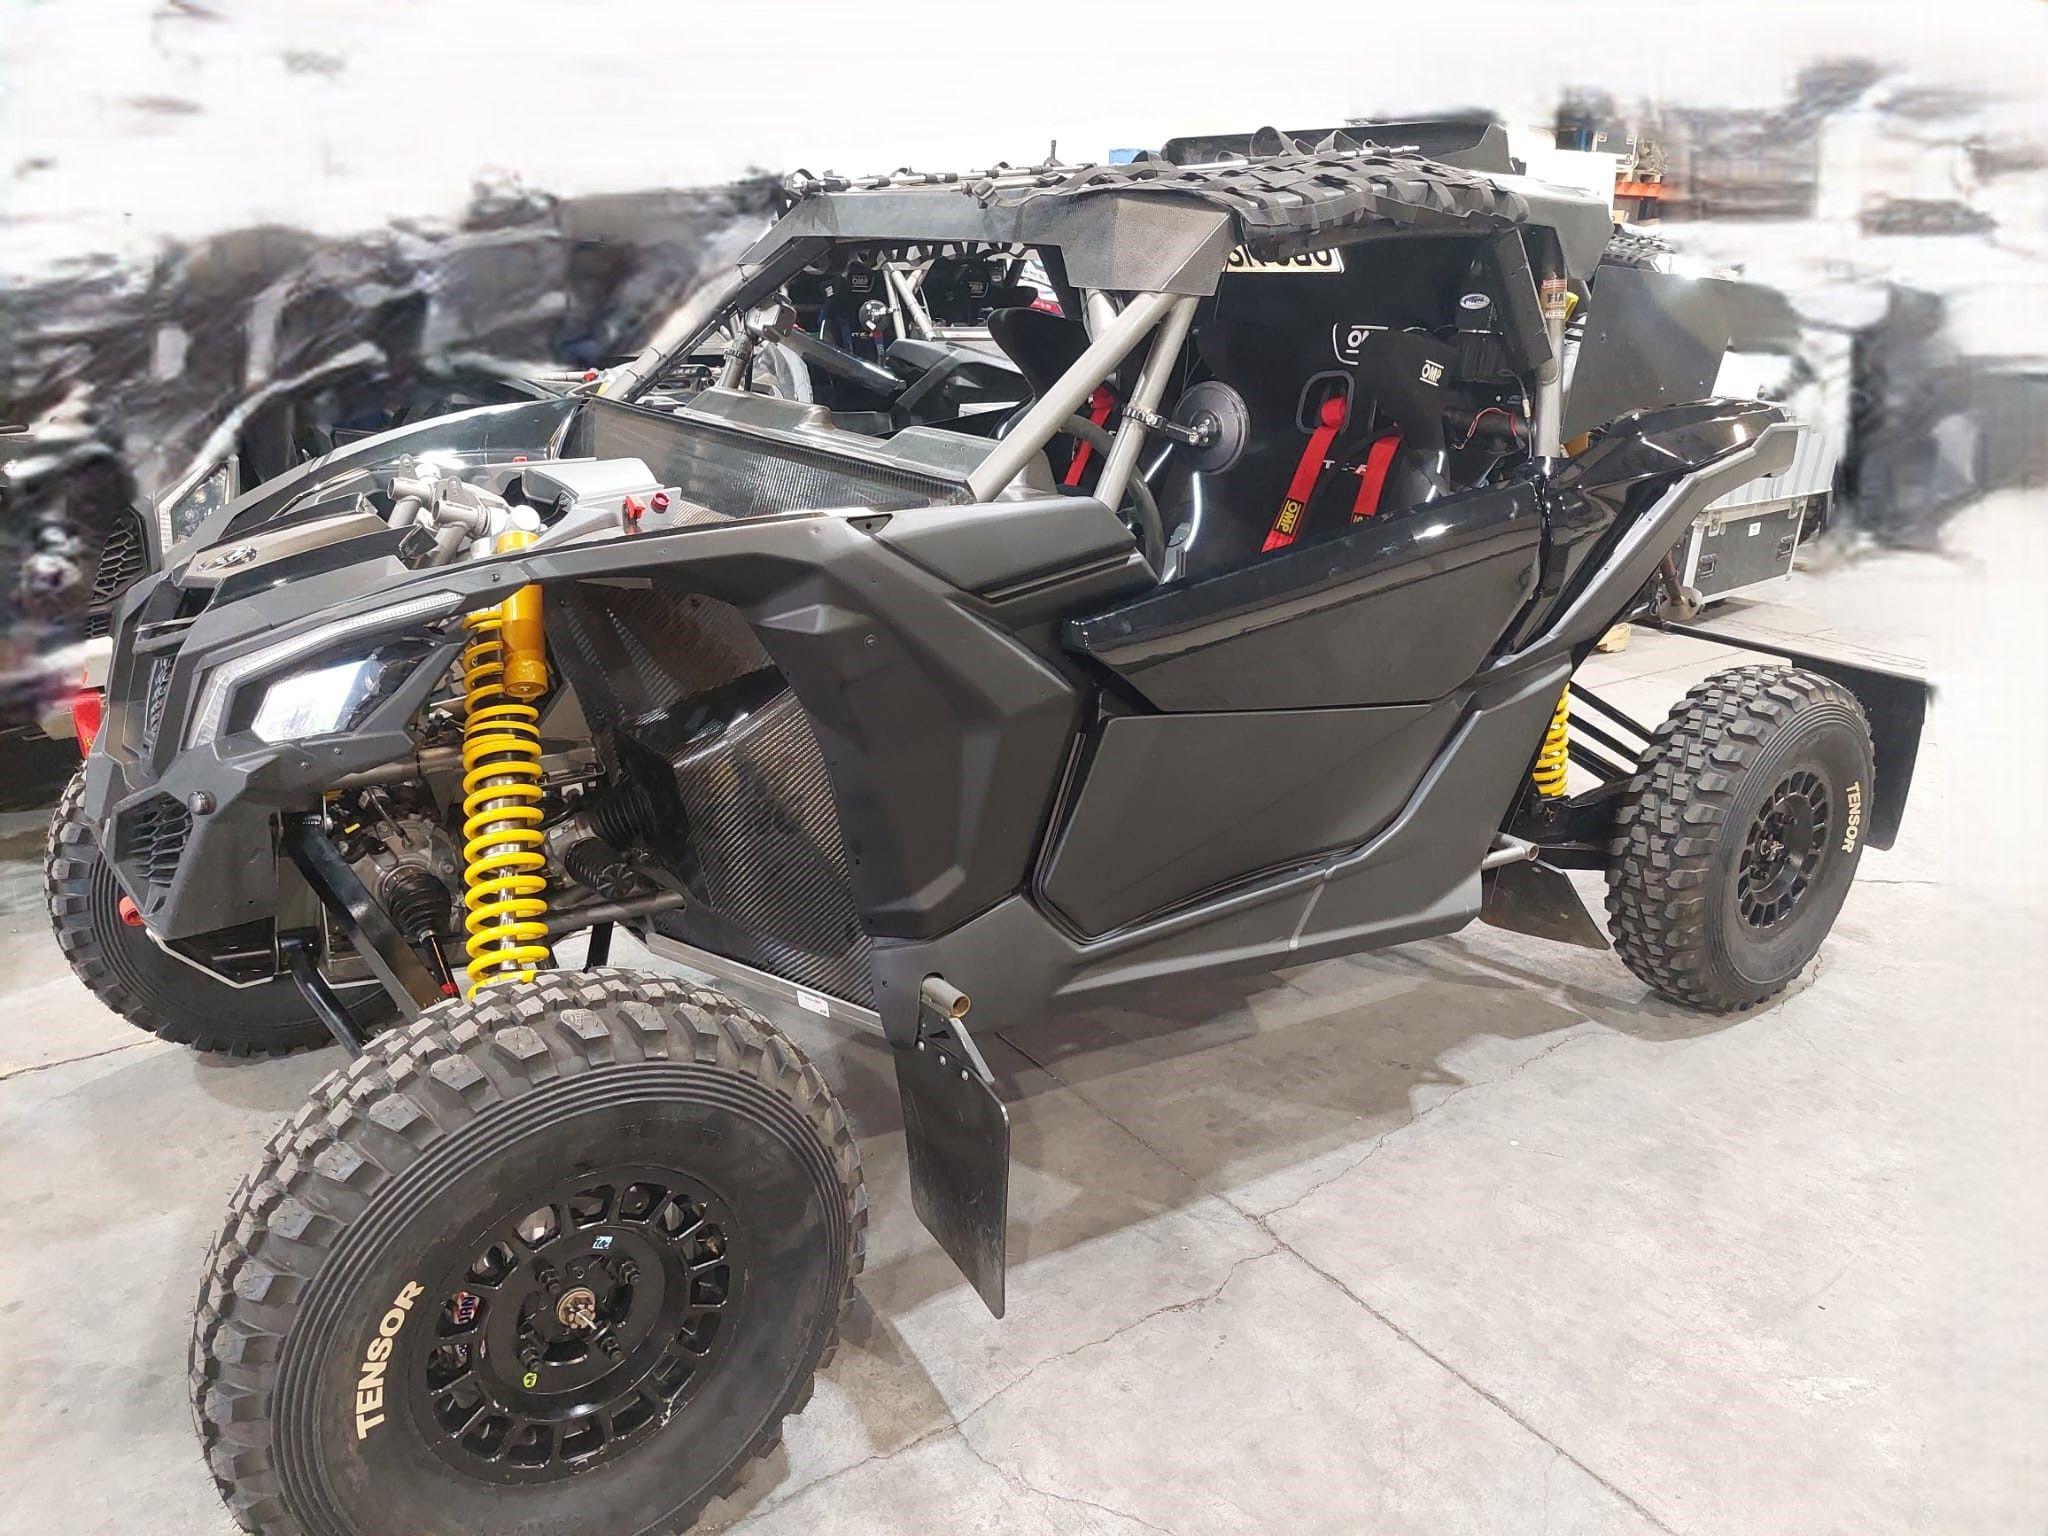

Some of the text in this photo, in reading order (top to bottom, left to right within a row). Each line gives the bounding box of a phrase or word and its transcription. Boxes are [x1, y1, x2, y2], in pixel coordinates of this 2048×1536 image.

[1421, 363, 1442, 383] OMP
[1280, 500, 1300, 533] OMP
[1841, 781, 1861, 853] TENSOR
[355, 1280, 425, 1440] TENSOR
